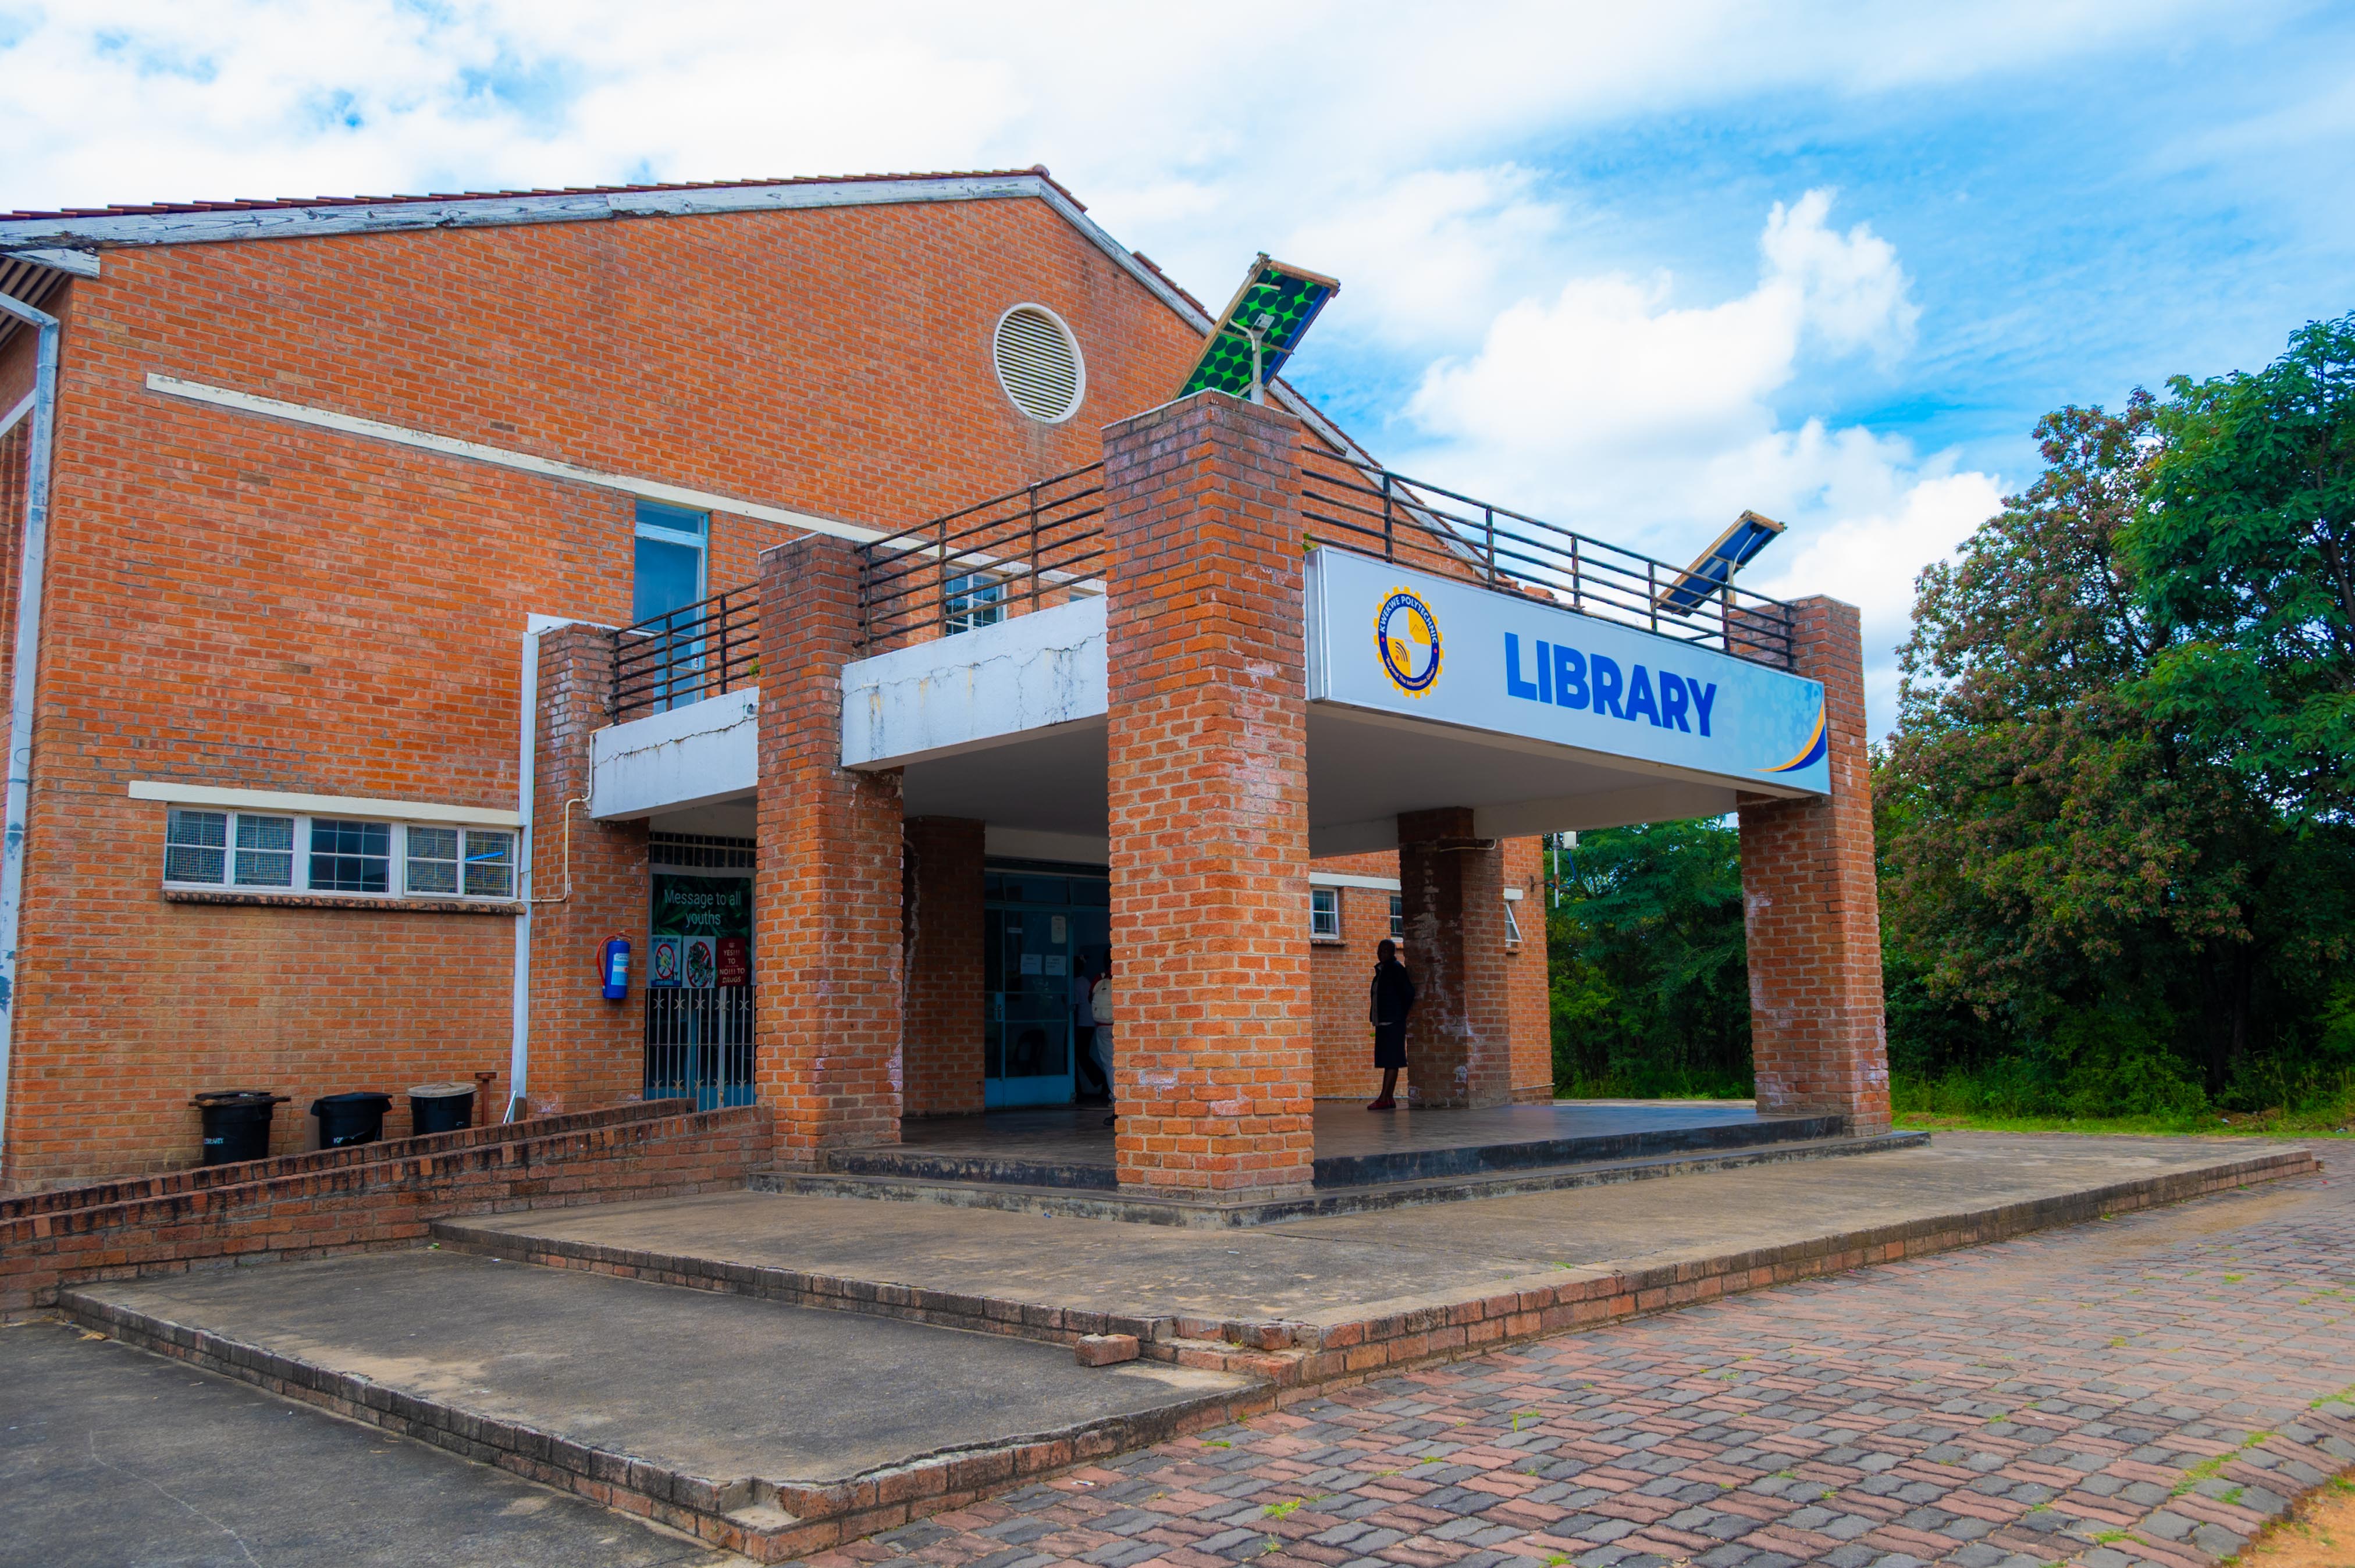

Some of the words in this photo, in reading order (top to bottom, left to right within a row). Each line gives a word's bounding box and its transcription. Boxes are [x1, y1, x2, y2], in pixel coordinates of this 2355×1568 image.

[1379, 597, 1400, 633] KWEKWE
[1401, 596, 1438, 644] POLYTECHNIC
[1504, 631, 1717, 738] LIBRARY
[664, 889, 714, 908] Message
[716, 892, 726, 906] to
[729, 890, 741, 906] all
[685, 910, 721, 928] youths
